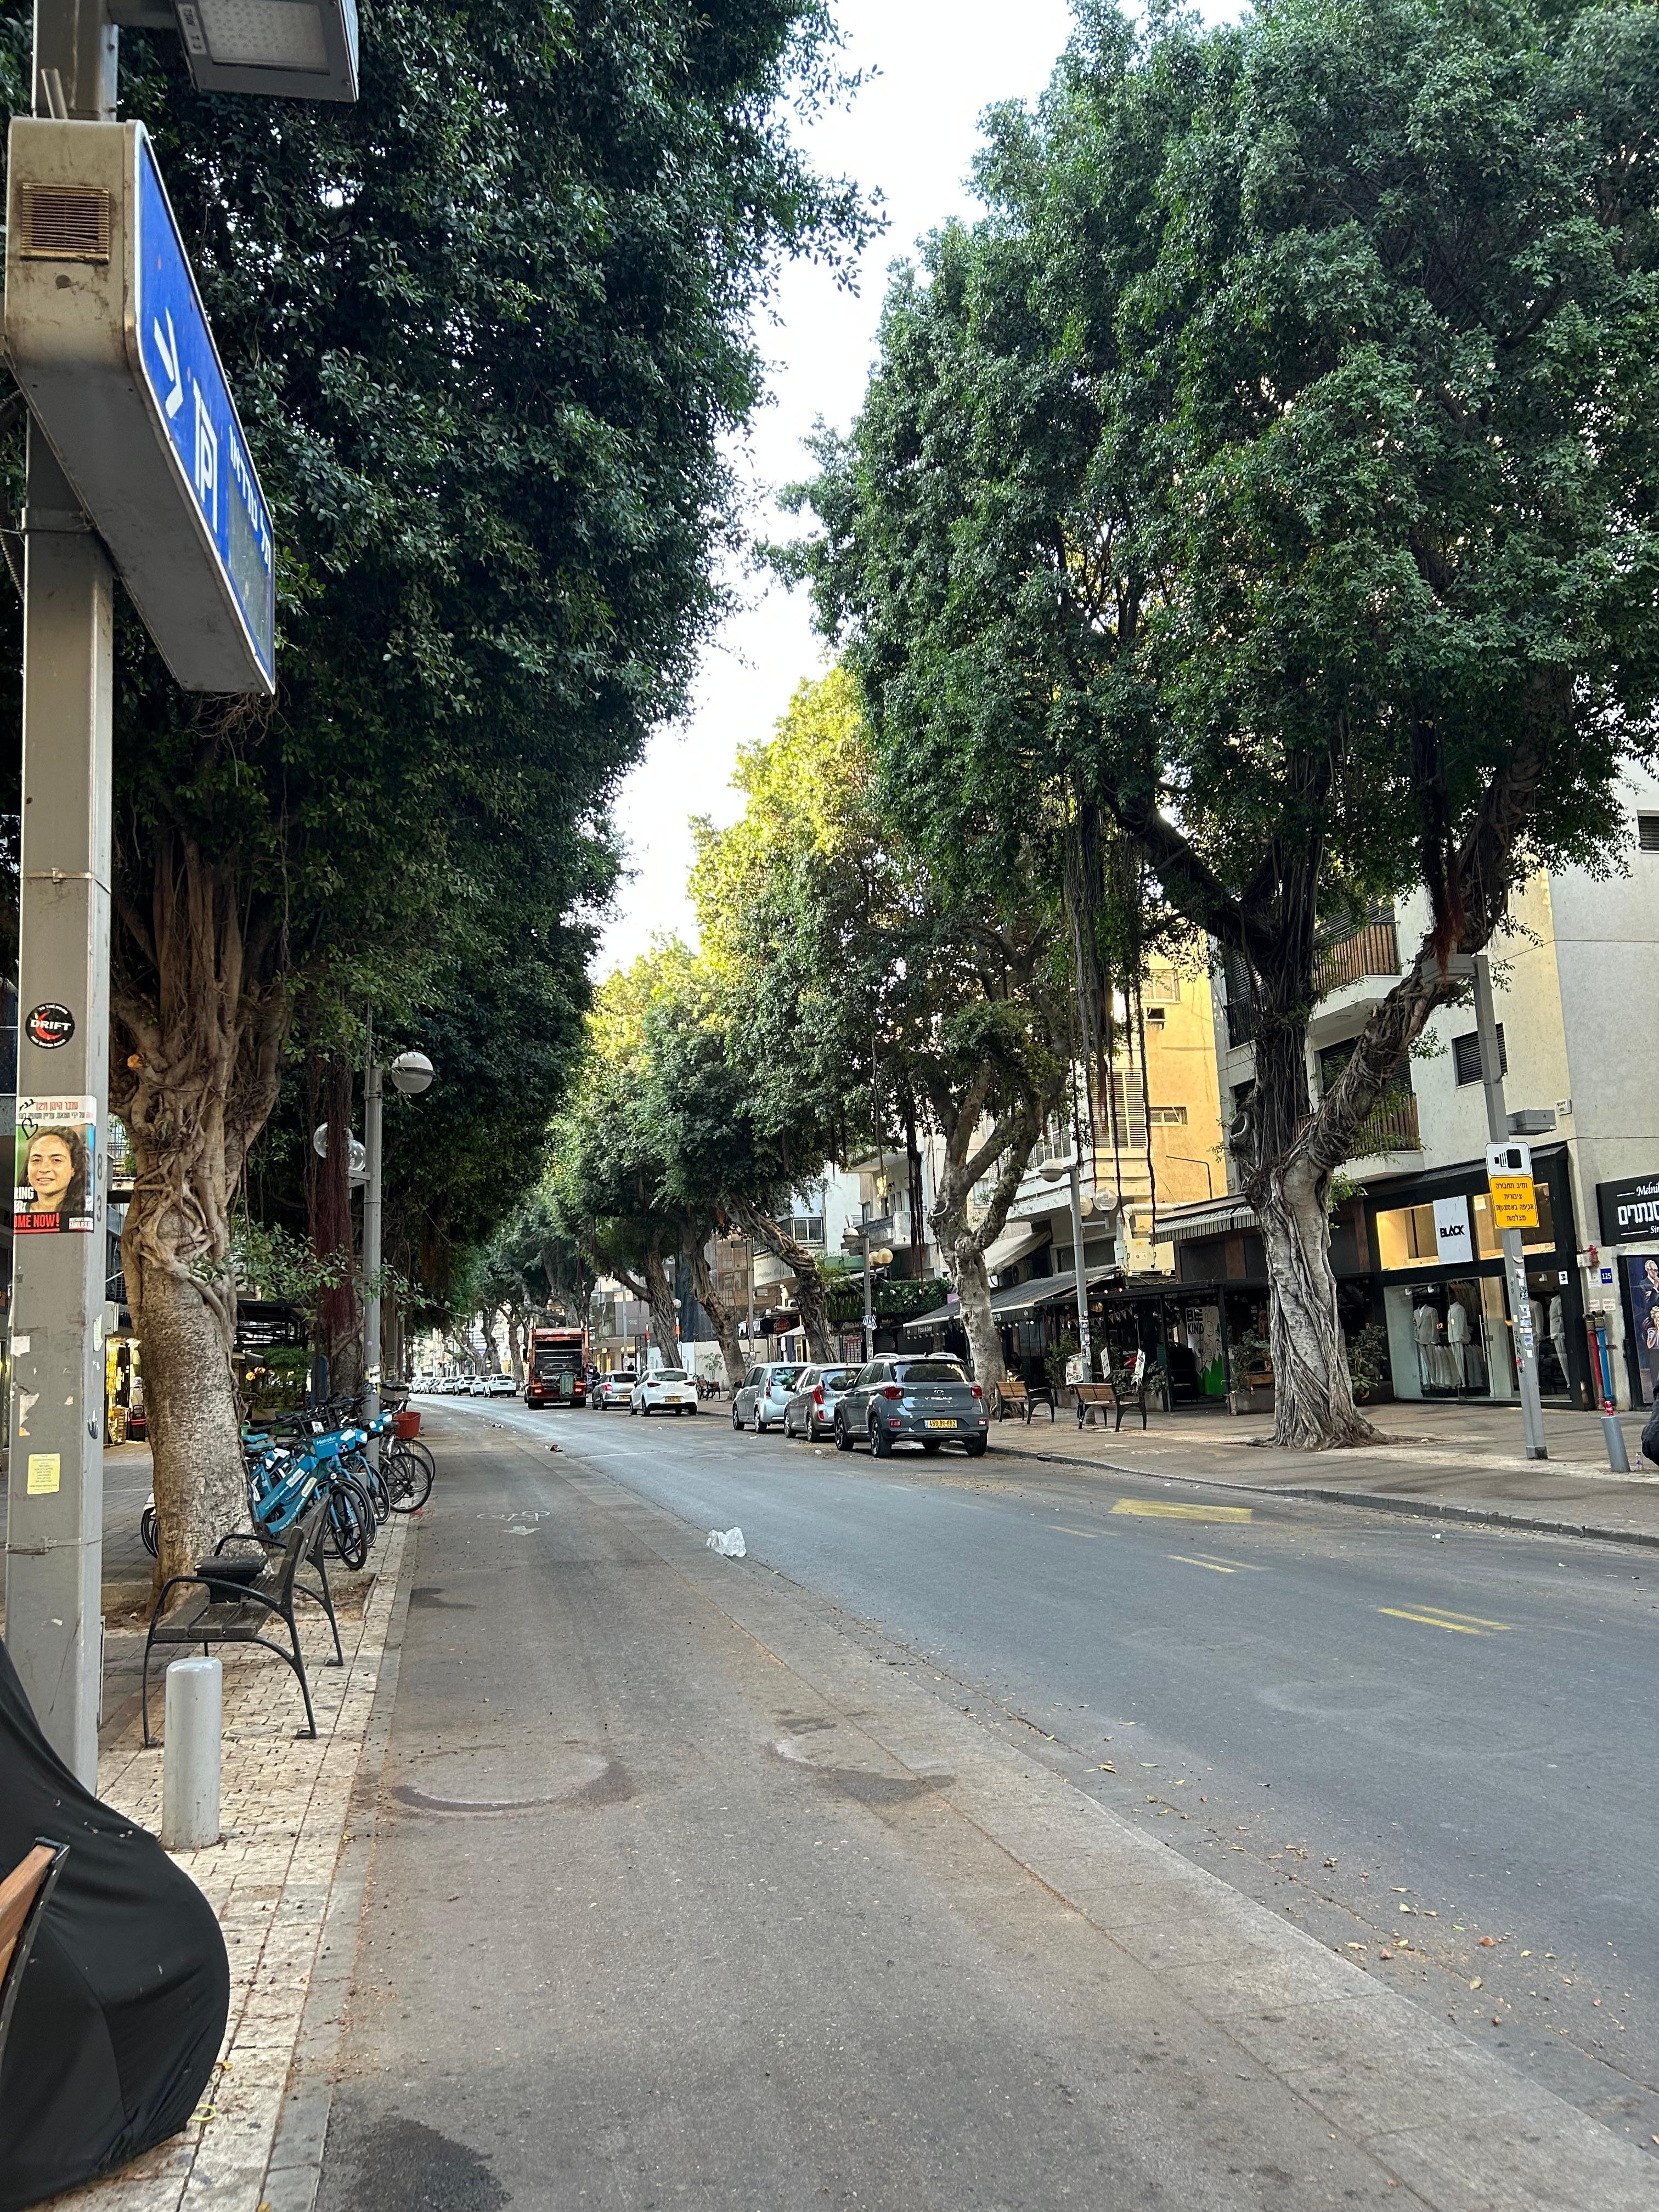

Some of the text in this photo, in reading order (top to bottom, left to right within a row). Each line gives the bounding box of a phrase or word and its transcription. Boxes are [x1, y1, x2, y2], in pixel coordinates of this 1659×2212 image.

[30, 1019, 71, 1031] DRIFT
[33, 1212, 60, 1228] NOW!
[1440, 1224, 1465, 1238] BLACK
[1187, 1308, 1203, 1322] BE
[1187, 1322, 1204, 1335] KIND
